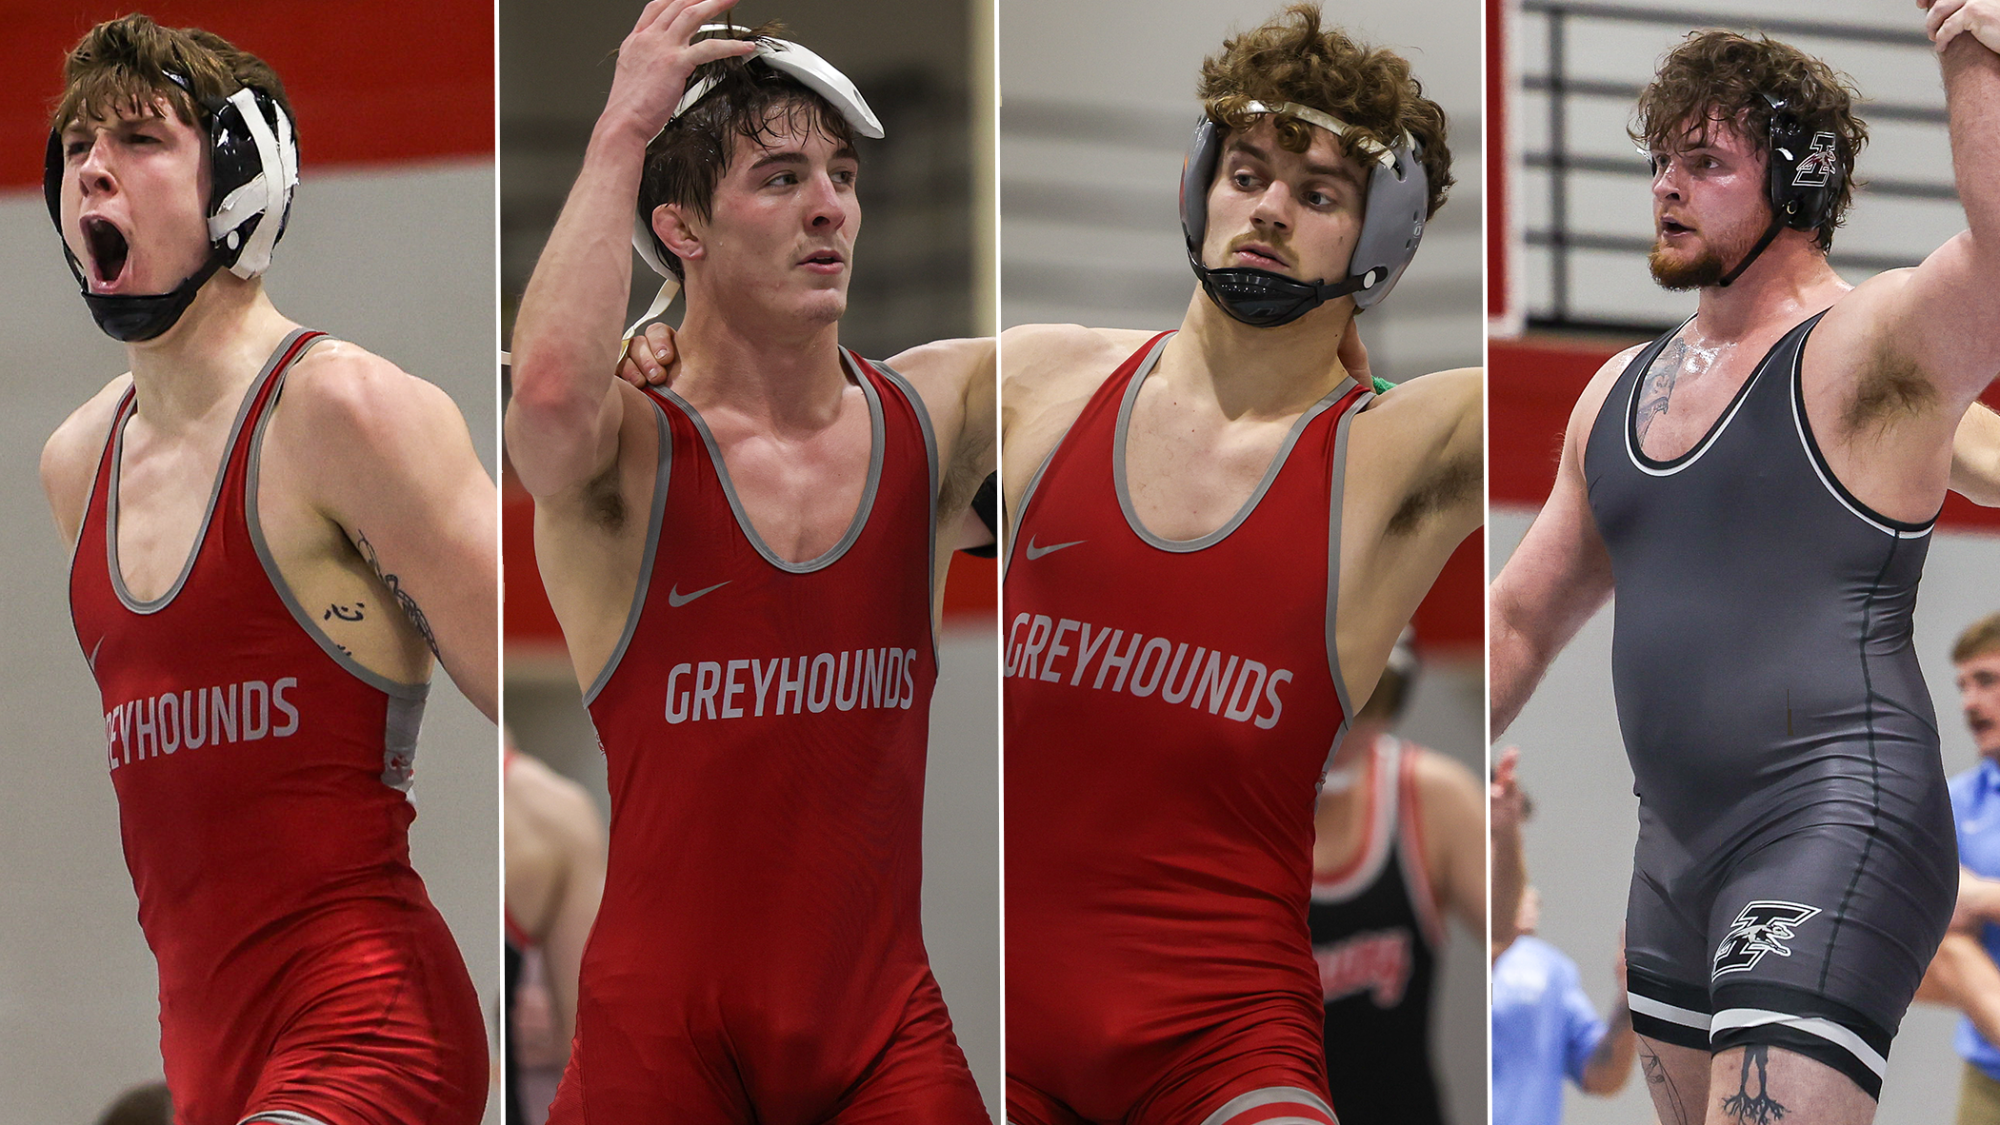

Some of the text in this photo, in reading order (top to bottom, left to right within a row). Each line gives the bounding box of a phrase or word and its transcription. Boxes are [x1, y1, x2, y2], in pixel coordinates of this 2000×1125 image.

[665, 647, 917, 725] GREYHOUNDS
[1003, 612, 1294, 730] GREYHOUNDS
[105, 677, 299, 771] EYHOUNDS
